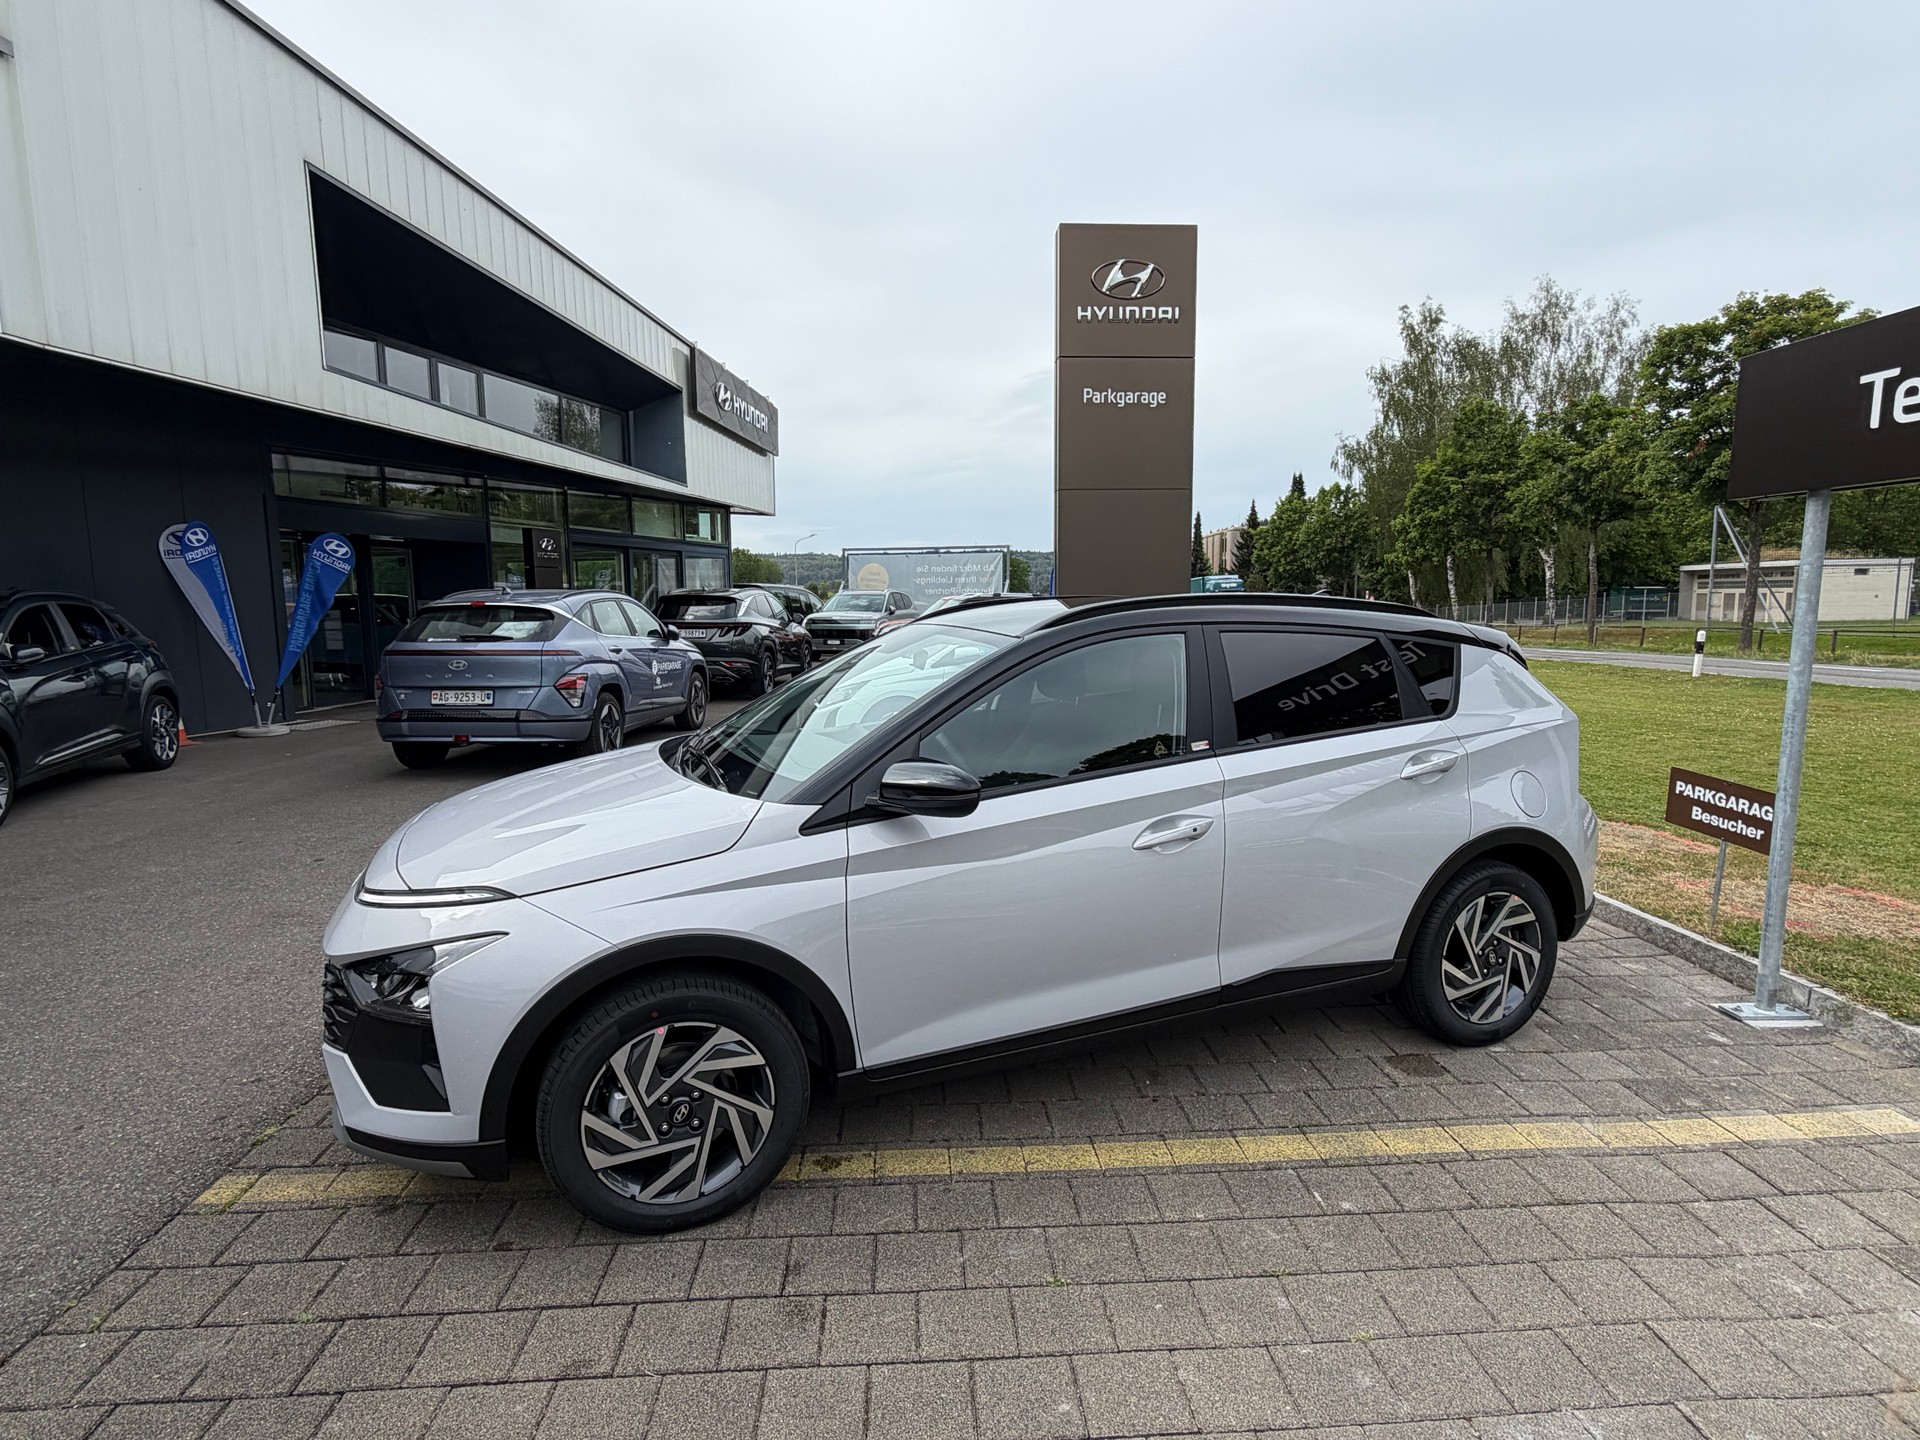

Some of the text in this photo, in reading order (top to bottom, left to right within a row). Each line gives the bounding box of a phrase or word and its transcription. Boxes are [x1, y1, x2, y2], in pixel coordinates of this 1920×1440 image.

[1077, 306, 1180, 322] HYUNDAI
[733, 394, 769, 433] HYUNDAI
[1083, 388, 1167, 407] Parkgarage
[312, 548, 351, 572] HYUNDAI
[289, 591, 314, 653] PARKGARAGE
[1675, 780, 1774, 822] PARKGARAG
[1691, 806, 1765, 841] Besucher
